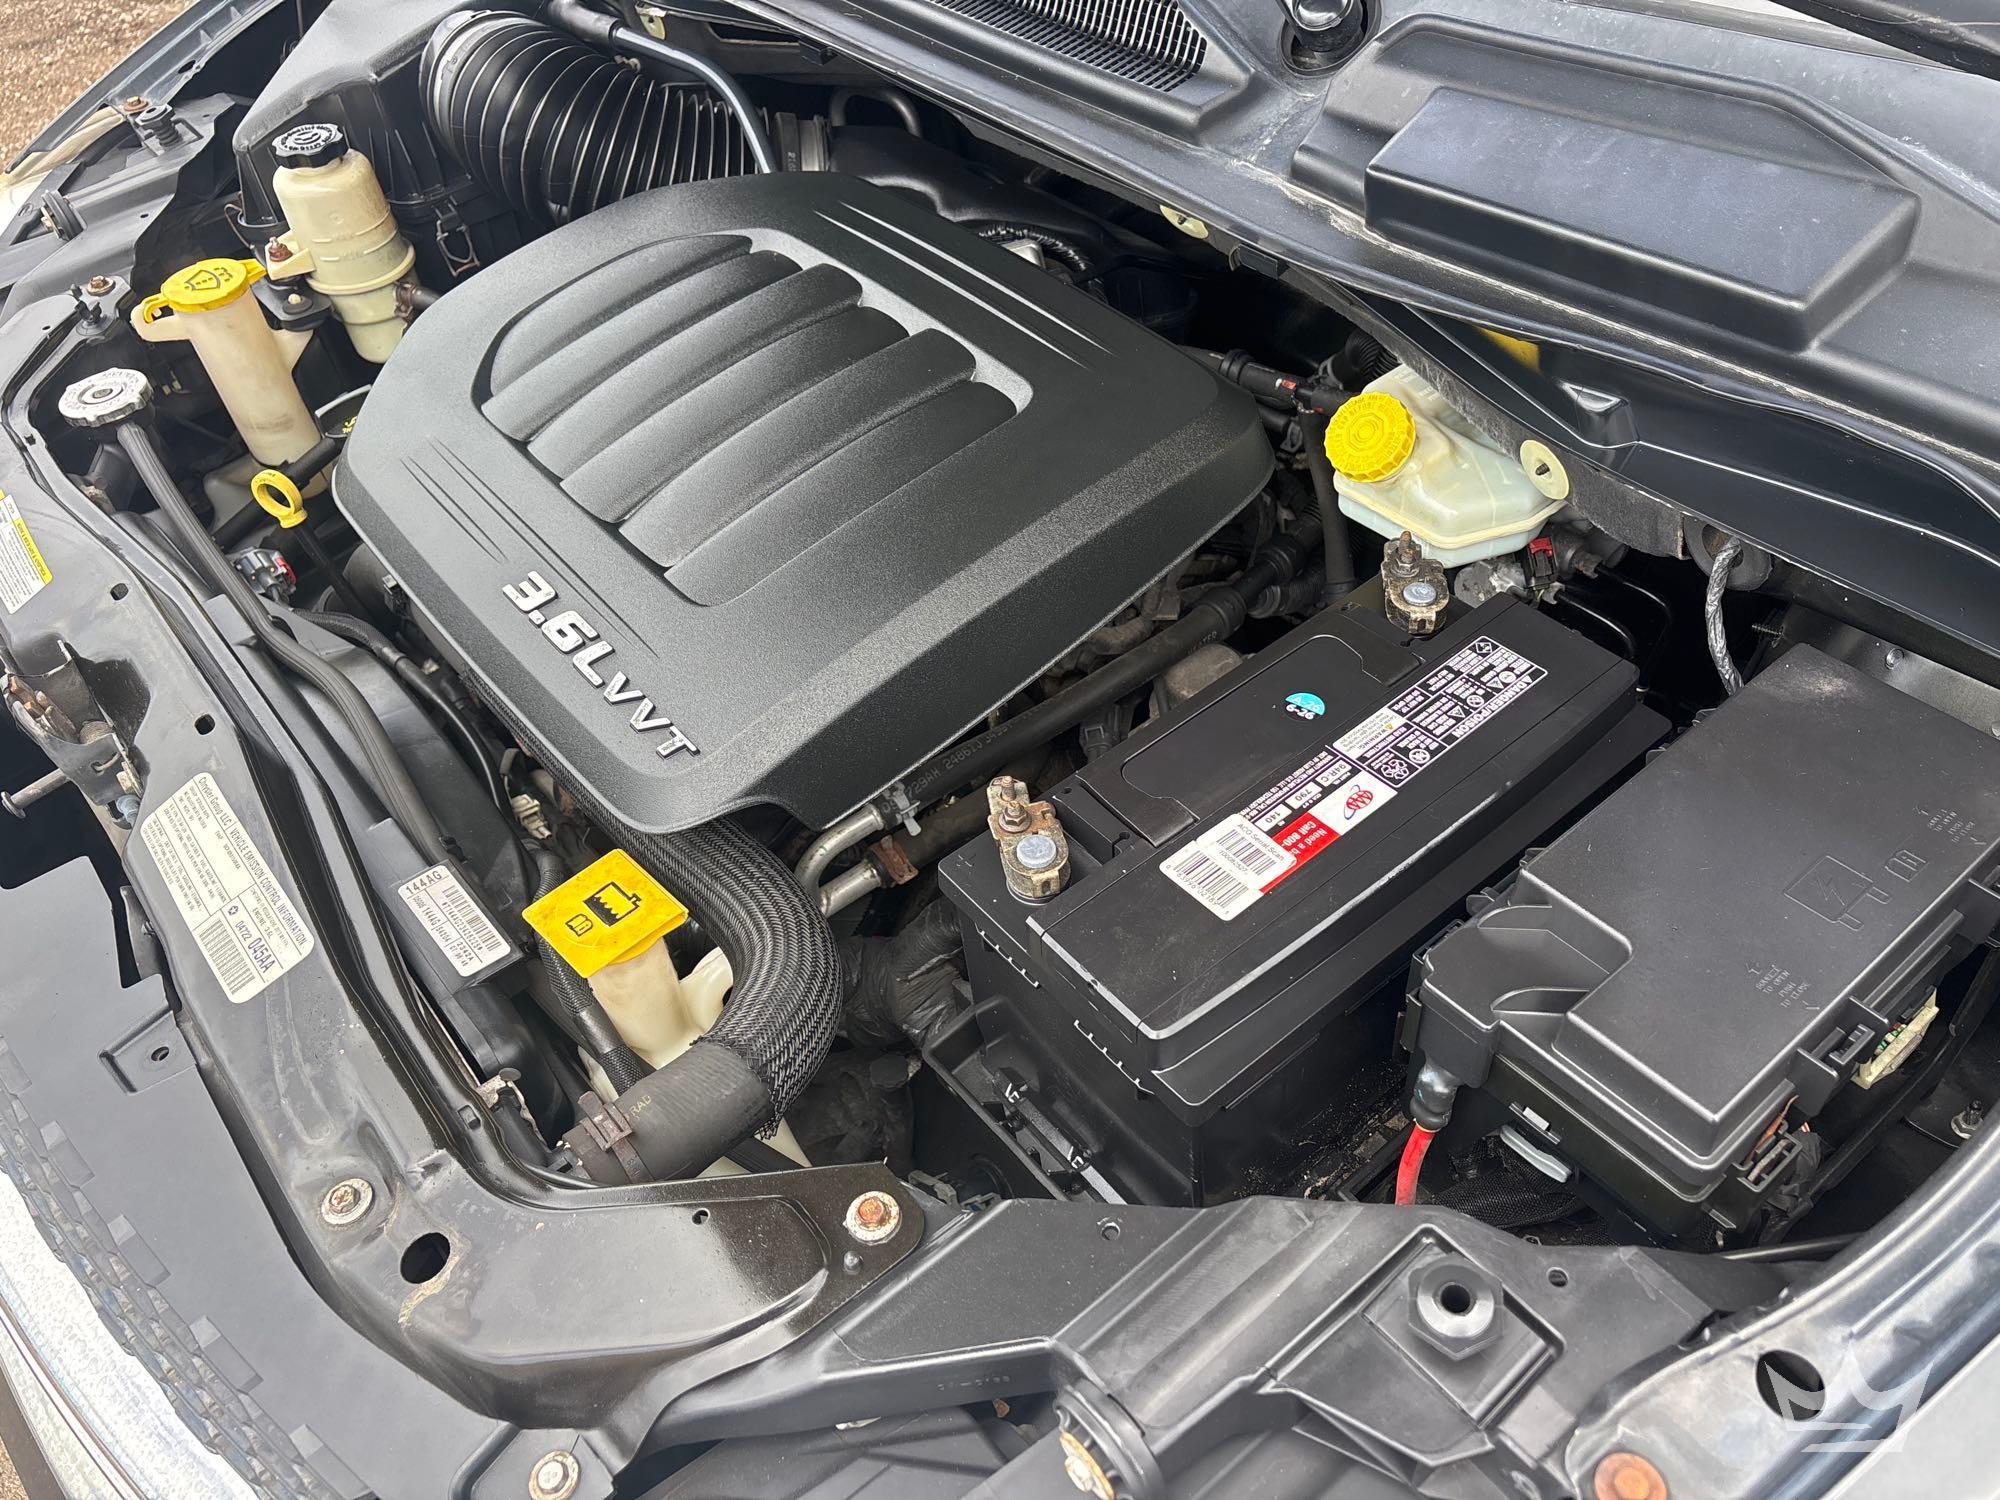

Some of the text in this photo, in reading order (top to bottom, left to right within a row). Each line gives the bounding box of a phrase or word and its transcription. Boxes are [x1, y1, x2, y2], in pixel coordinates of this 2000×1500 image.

[1285, 702, 1315, 720] 6-26
[1450, 680, 1527, 739] DANGER/POISON
[1319, 762, 1347, 782] 94R-C
[1293, 788, 1312, 801] 790
[1263, 810, 1281, 823] 140
[1296, 820, 1317, 835] Call
[1303, 827, 1328, 845] Need
[1236, 821, 1285, 861] ACG Serial Scan
[195, 776, 216, 800] Chrysler
[207, 796, 225, 816] Group
[218, 812, 232, 826] LLC
[228, 827, 249, 853] VEHICLE
[241, 849, 266, 880] EMISSION
[258, 876, 282, 906] CONTROL
[274, 902, 308, 946] INFORMATION
[404, 869, 442, 896] 144AG
[421, 906, 441, 927] 144AG
[233, 919, 253, 942] 04722
[245, 936, 278, 973] 045AA
[455, 940, 474, 961] 2342A
[629, 1094, 653, 1119] RAD
